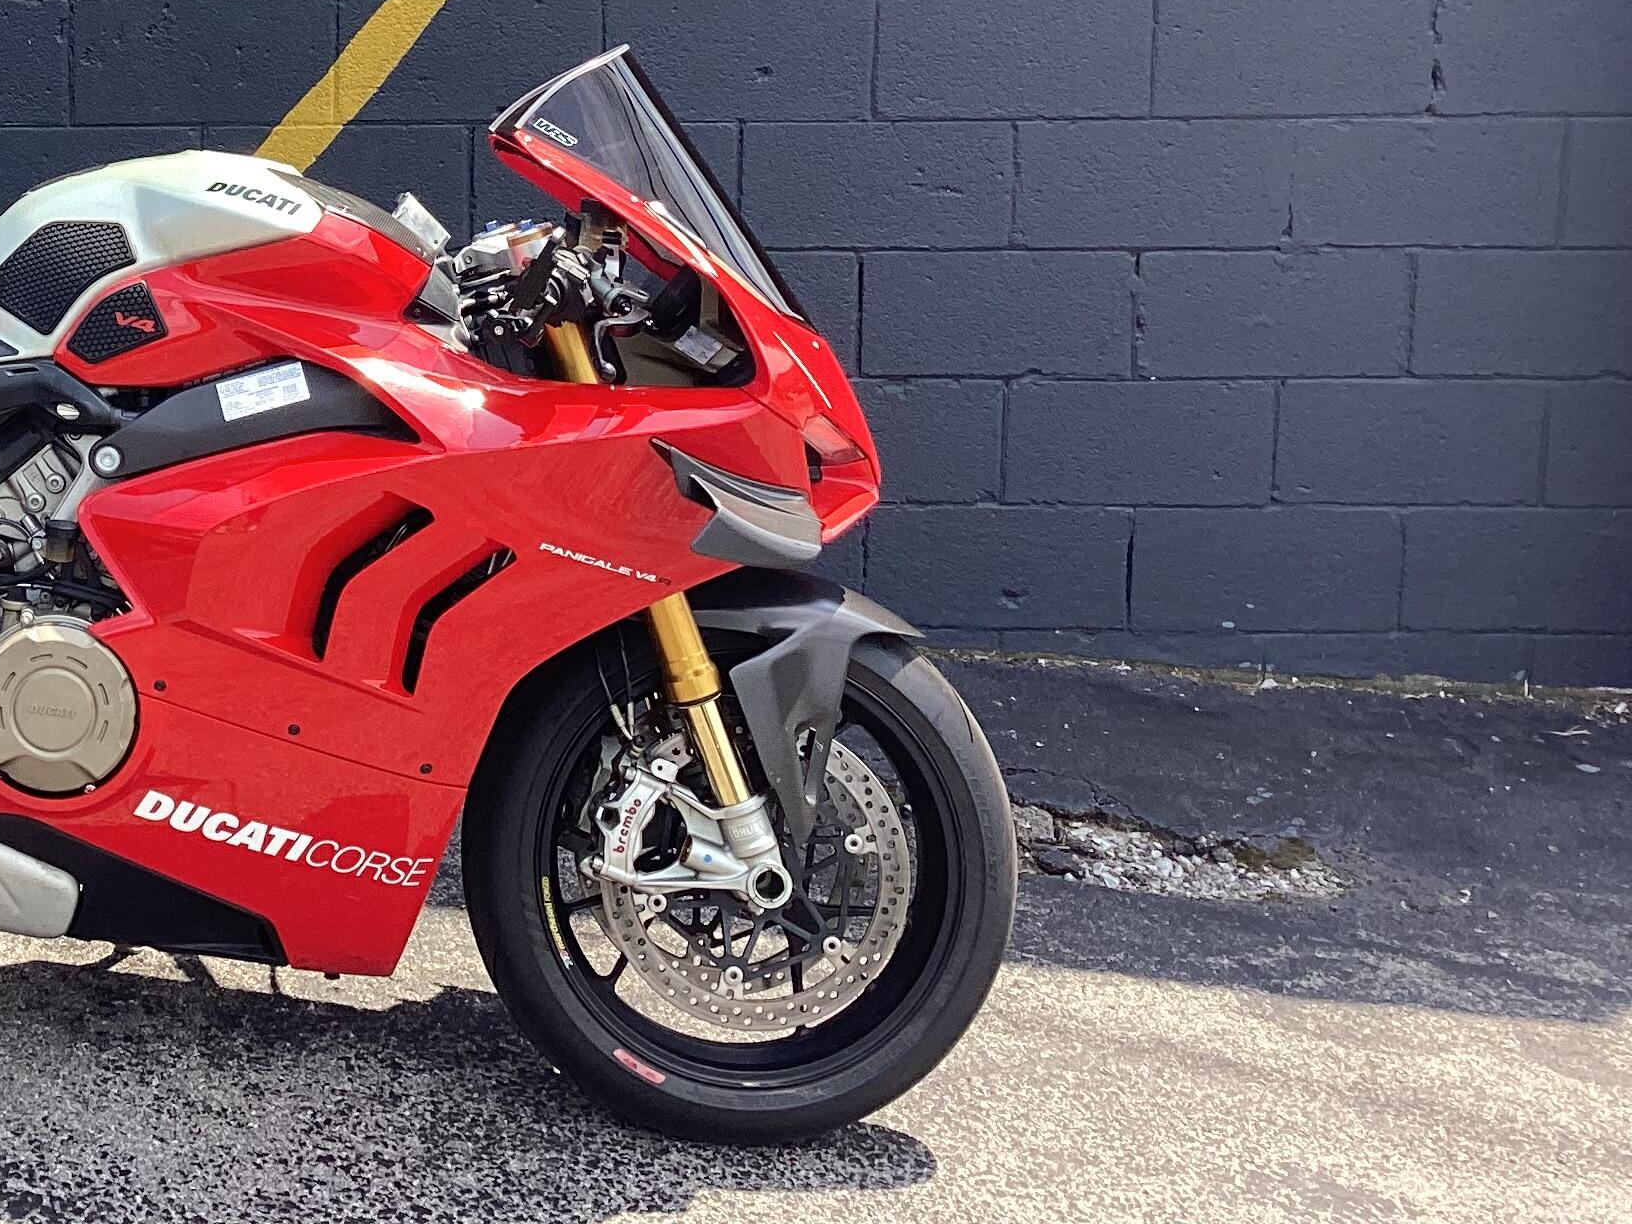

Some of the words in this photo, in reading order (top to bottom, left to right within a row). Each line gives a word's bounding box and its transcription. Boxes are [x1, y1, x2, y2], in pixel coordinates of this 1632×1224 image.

[205, 181, 303, 216] DUCATI
[114, 311, 155, 333] V4
[635, 570, 657, 583] V4
[133, 789, 314, 862] DUCATI
[305, 839, 435, 887] CORSE
[612, 798, 643, 854] brembo
